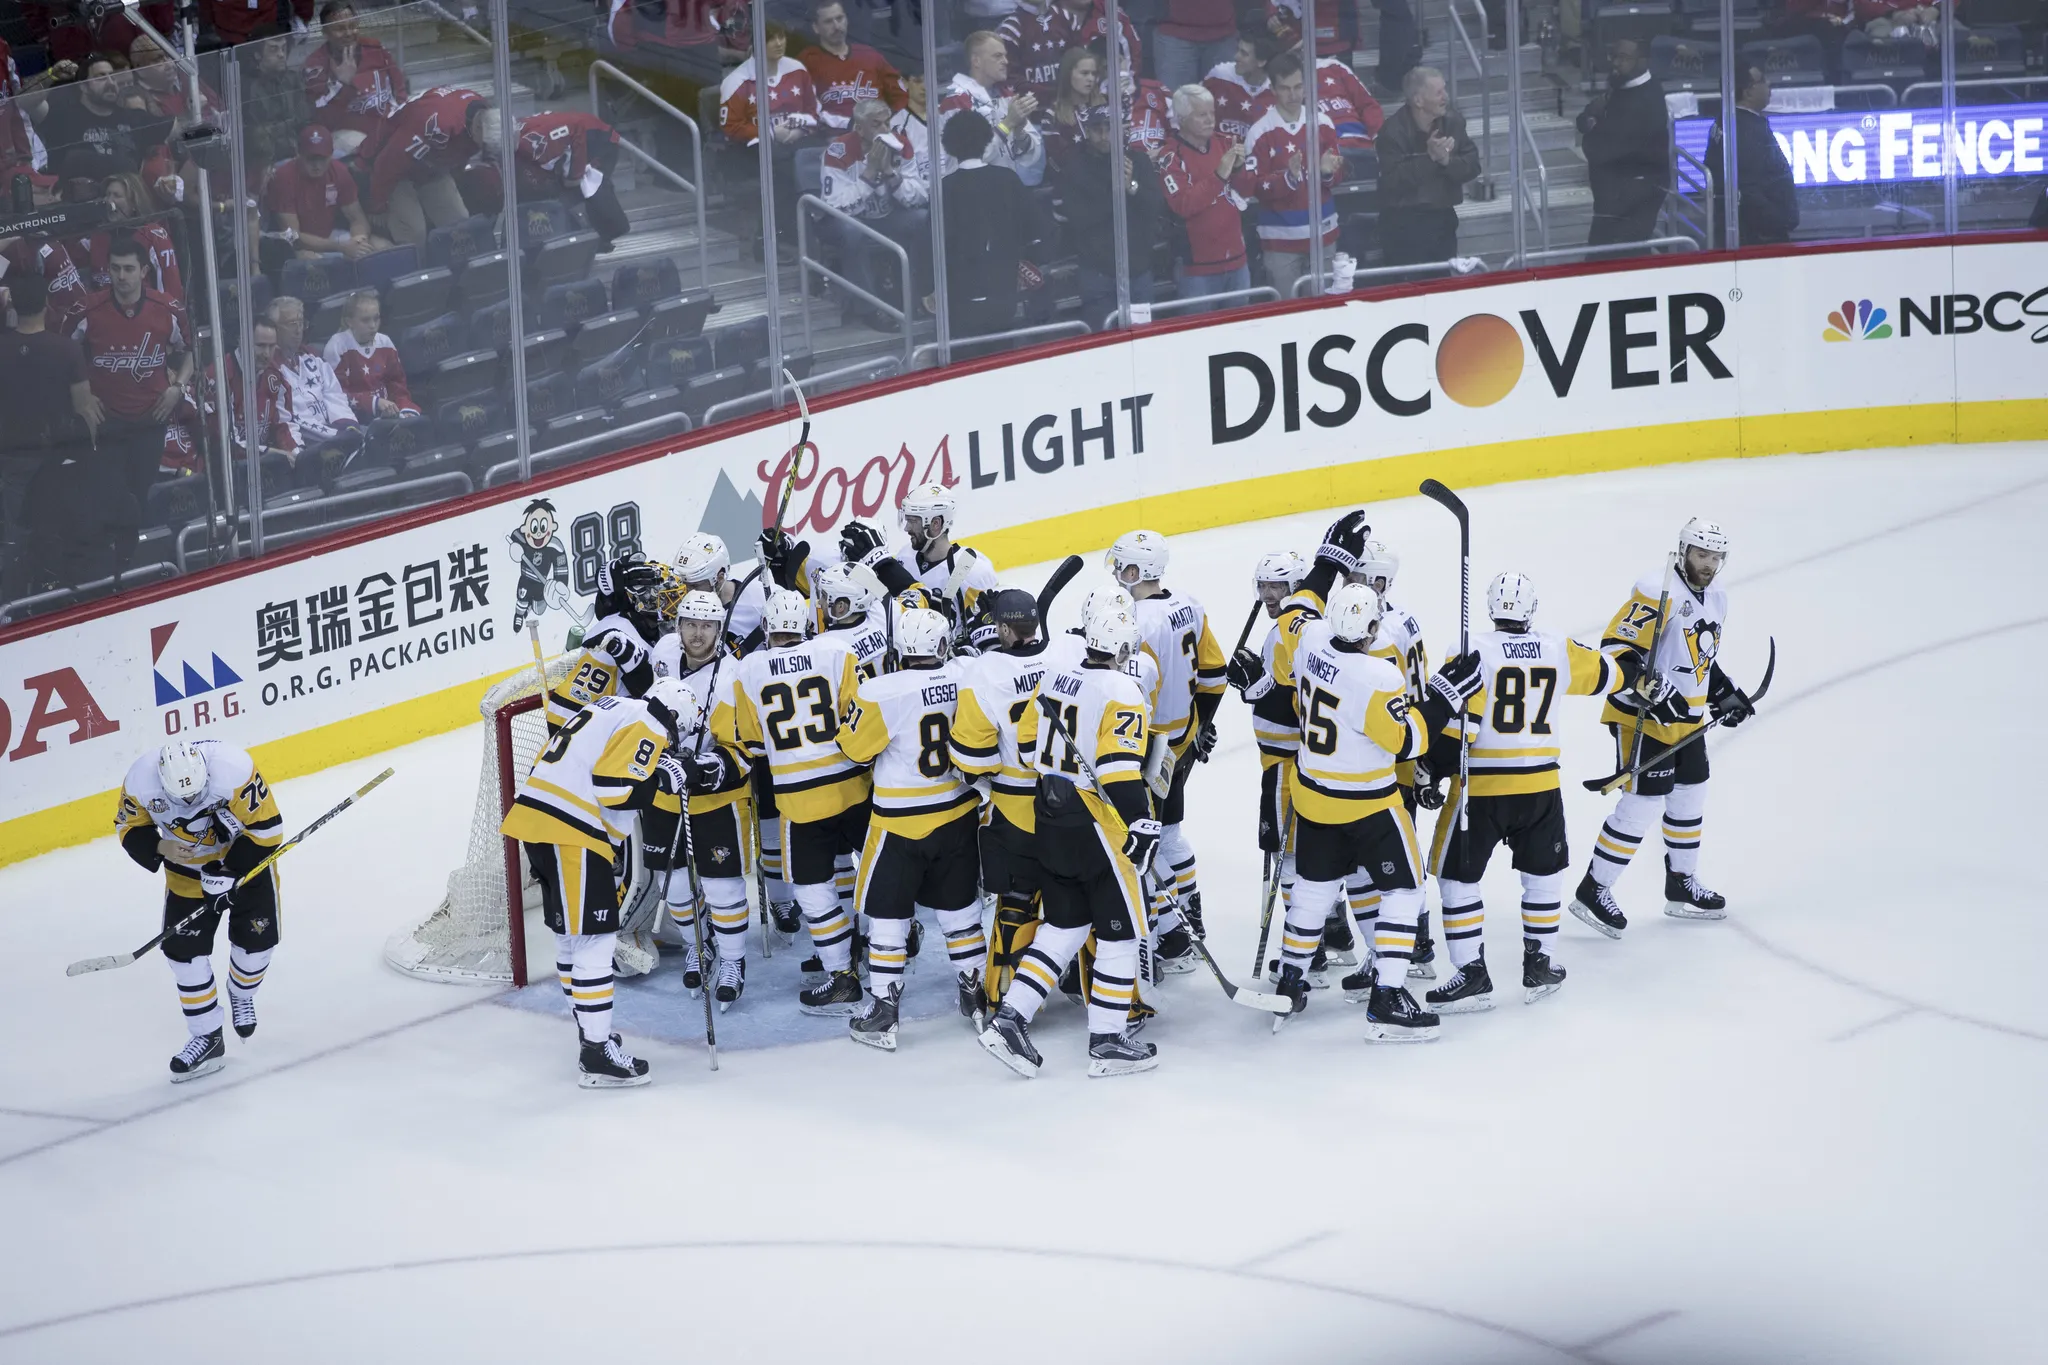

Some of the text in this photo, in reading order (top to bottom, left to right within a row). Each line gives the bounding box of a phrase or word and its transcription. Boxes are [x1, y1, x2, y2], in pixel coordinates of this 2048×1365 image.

[820, 70, 878, 104] capitals
[405, 134, 431, 161] 70
[1880, 113, 2044, 179] FENCE
[1164, 174, 1179, 195] 8
[93, 332, 165, 382] capitals
[302, 357, 318, 373] C
[1208, 292, 1734, 446] DISCOVER
[267, 374, 280, 393] C
[757, 393, 1154, 536] Coors LIGHT
[571, 501, 643, 597] 88
[678, 555, 689, 565] 28
[256, 542, 491, 672] 奥瑞金包装
[1502, 601, 1515, 611] 87
[1621, 600, 1659, 631] 17
[783, 620, 798, 630] 23
[907, 646, 917, 655] 81
[1090, 637, 1099, 647] 71
[1502, 641, 1542, 660] CROSBY
[261, 618, 495, 706] O.R.G. PACKAGING
[571, 661, 612, 695] 29
[769, 654, 813, 676] WILSON
[929, 674, 947, 682] Reebok
[1306, 651, 1340, 685] HAINSEY
[1051, 673, 1083, 698] MALKIN
[1492, 666, 1558, 735] 87
[0, 666, 121, 762] A
[164, 692, 247, 736] O.R.G.
[760, 675, 838, 751] 23
[1113, 710, 1143, 740] 71
[1299, 675, 1341, 756] 65
[541, 709, 595, 764] 8
[1040, 696, 1080, 775] 71
[633, 737, 657, 767] 8
[177, 776, 192, 789] 72
[1647, 767, 1676, 778] CCM
[239, 772, 269, 813] 72
